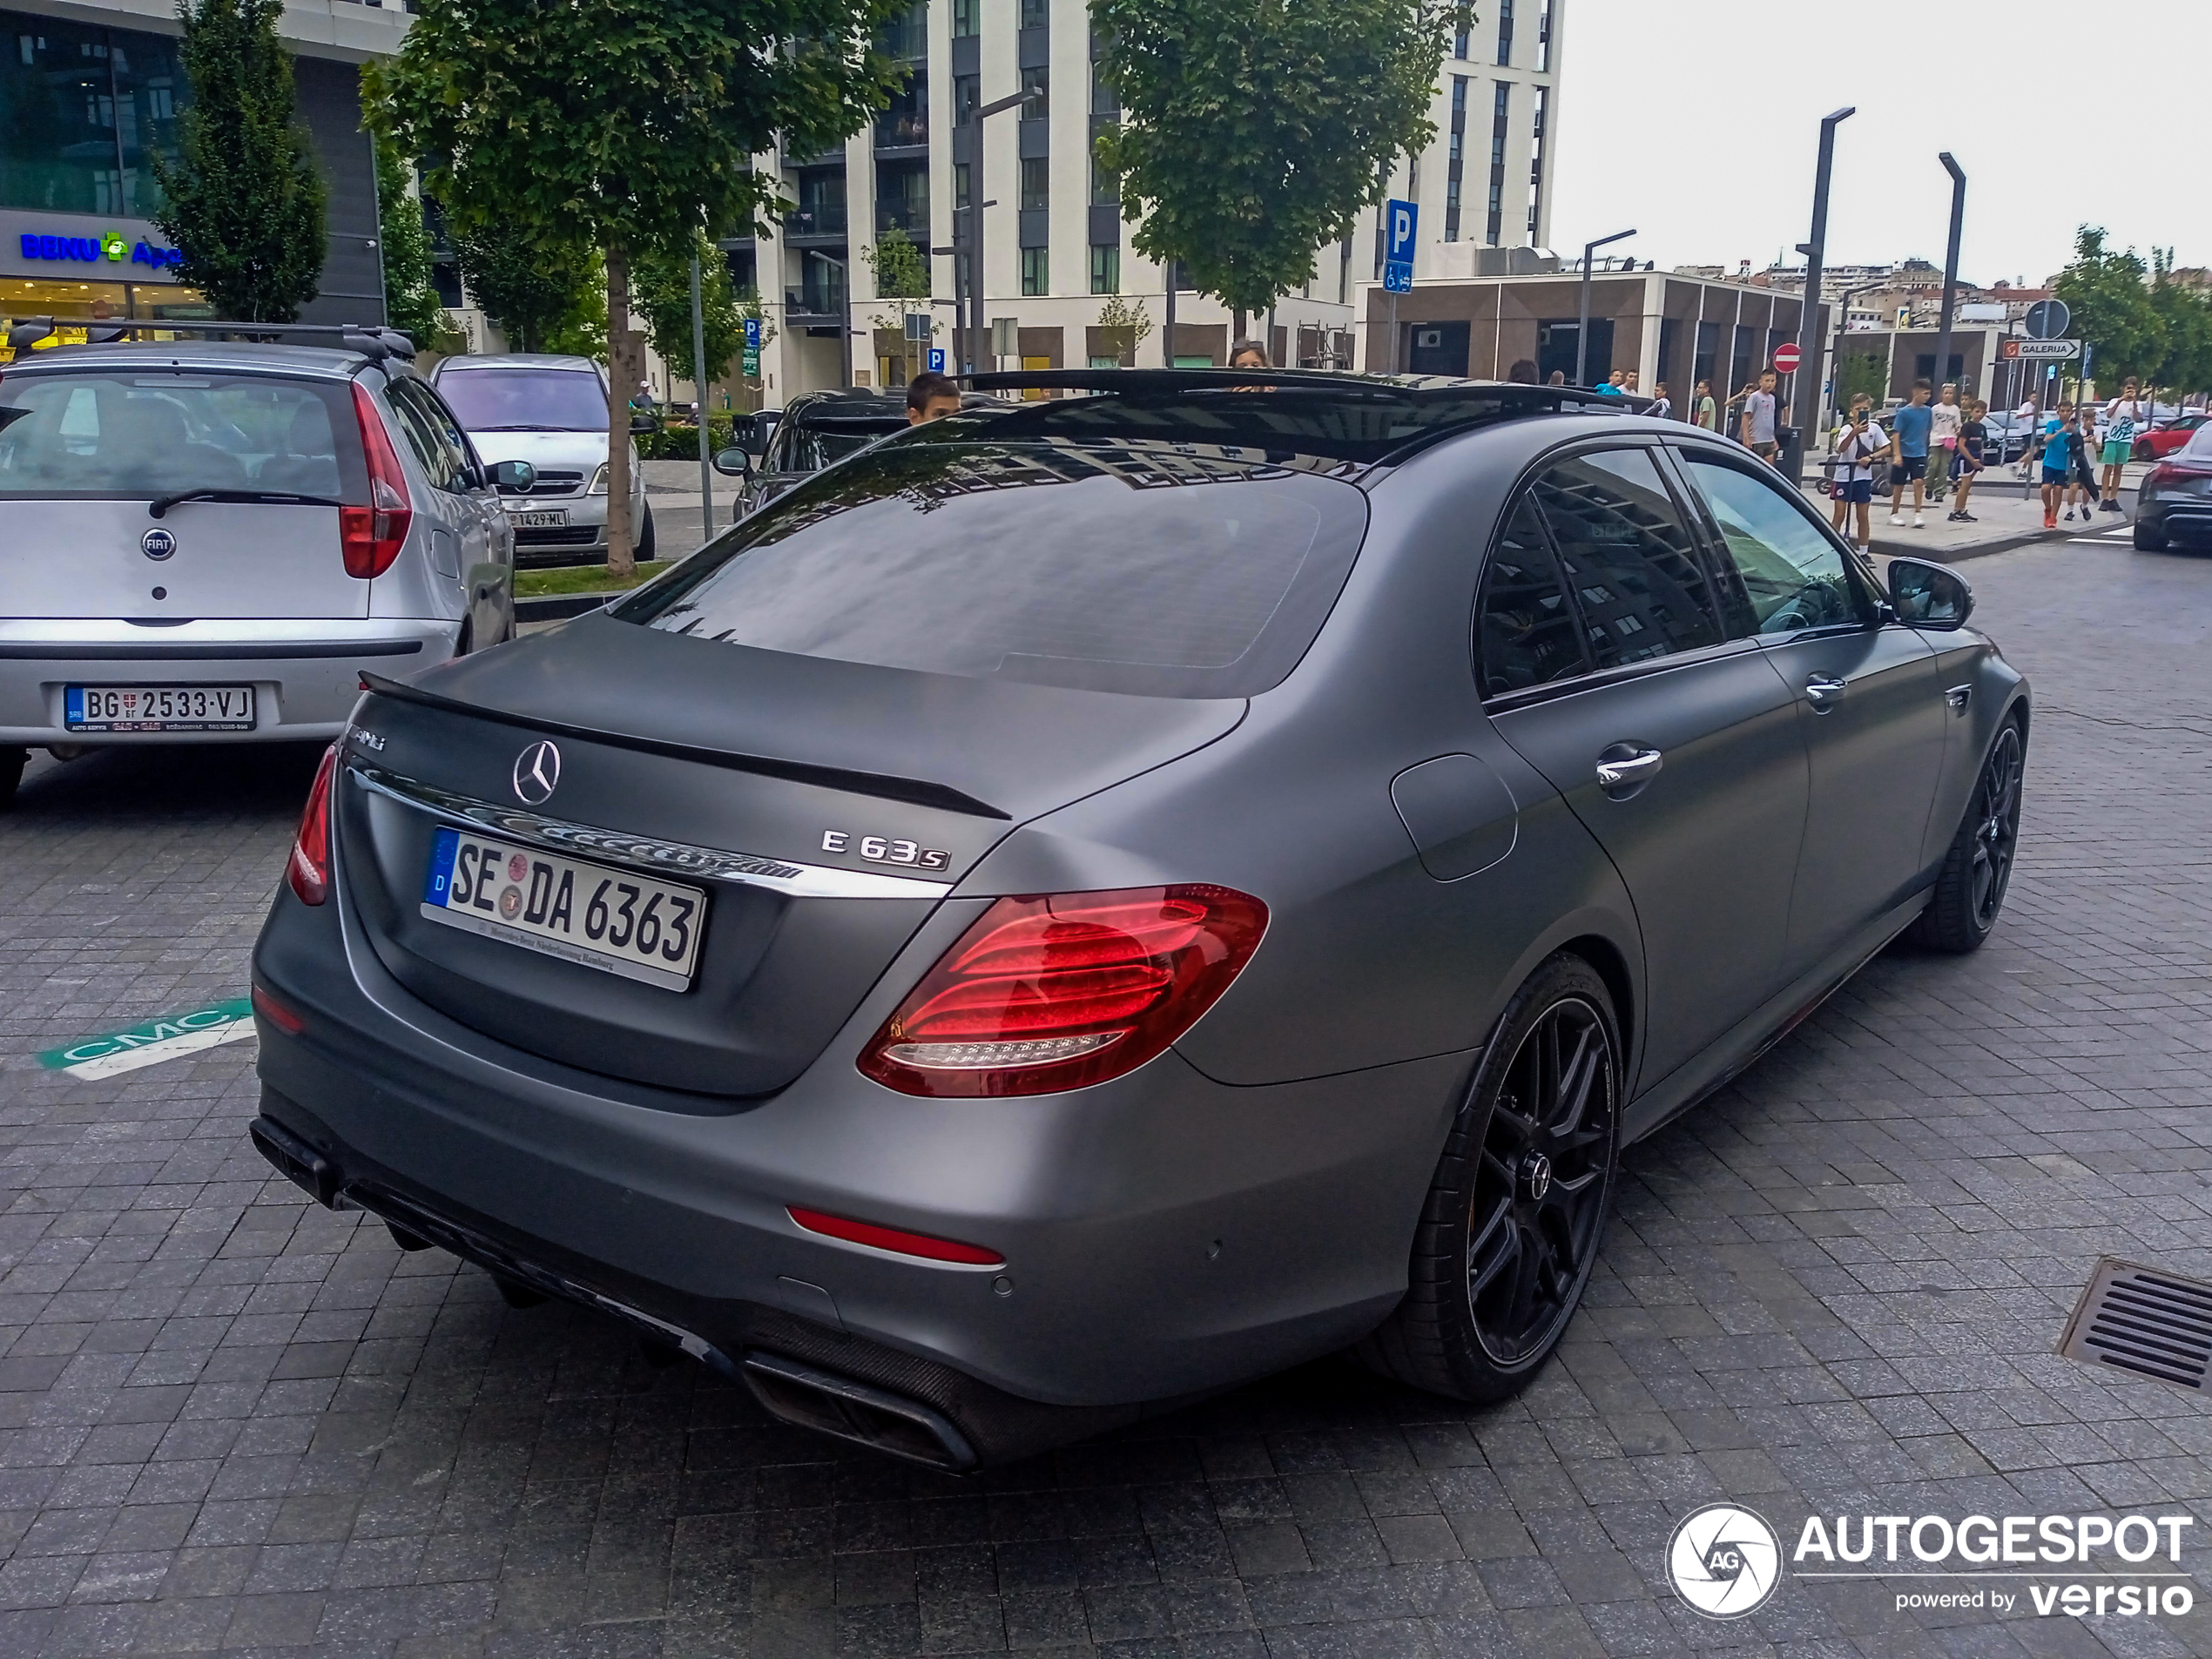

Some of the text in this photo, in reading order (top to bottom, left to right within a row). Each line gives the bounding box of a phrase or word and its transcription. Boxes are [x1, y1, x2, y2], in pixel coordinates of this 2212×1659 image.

[1393, 209, 1411, 253] P
[21, 234, 183, 269] BENU Apo
[746, 321, 757, 337] P
[932, 351, 941, 368] P
[2021, 345, 2067, 354] GALERIJA
[146, 539, 170, 550] FIAT
[88, 691, 119, 718] BG
[821, 830, 851, 853] E
[435, 874, 445, 892] D
[451, 843, 696, 962] SE DA 6363
[490, 927, 615, 972] Mercedes-Benz Niederlassung Hamburg
